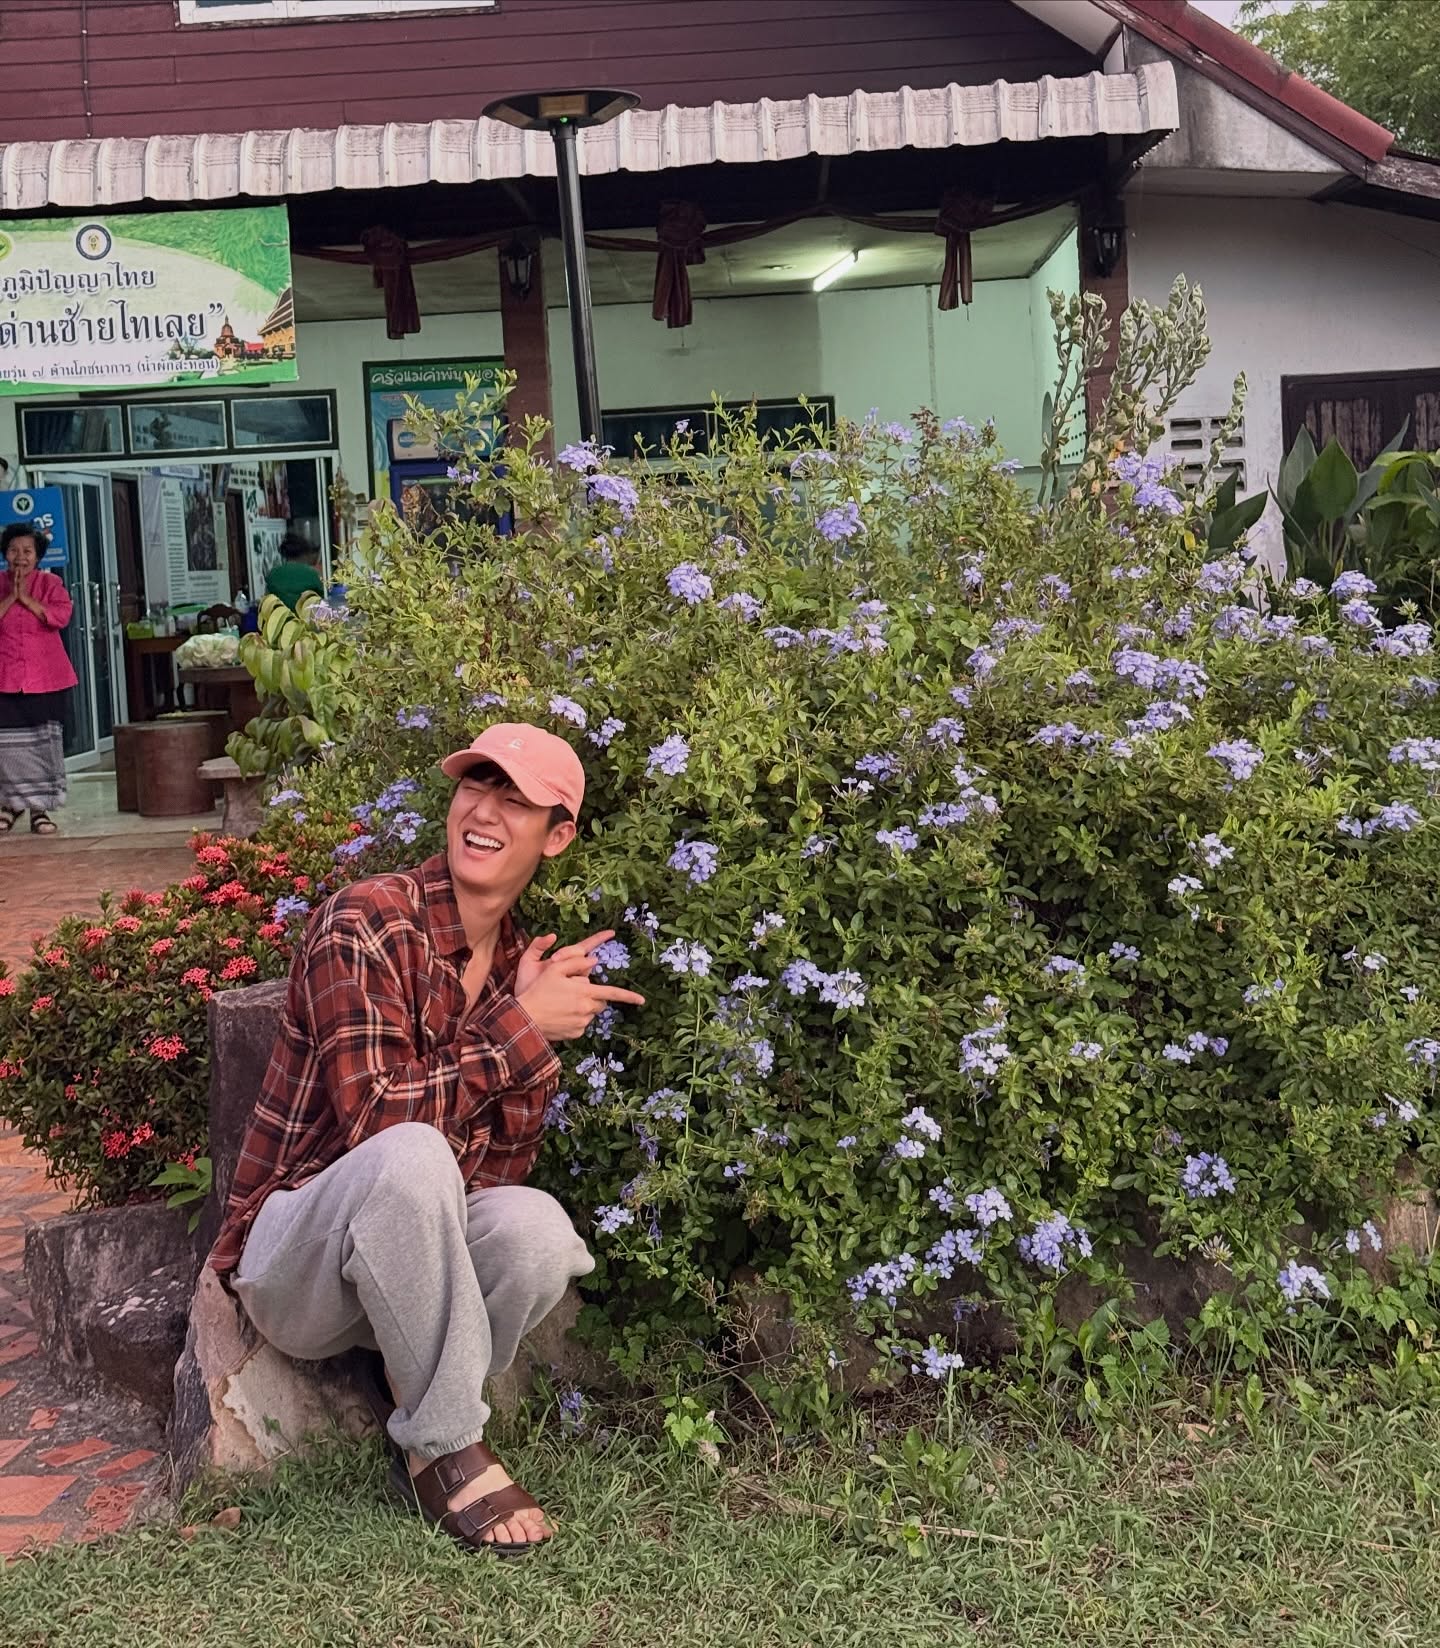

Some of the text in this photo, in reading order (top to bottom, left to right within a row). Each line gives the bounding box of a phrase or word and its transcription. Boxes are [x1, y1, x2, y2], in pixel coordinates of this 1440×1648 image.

[3, 262, 155, 300] ภูมิปัญญาไทย
